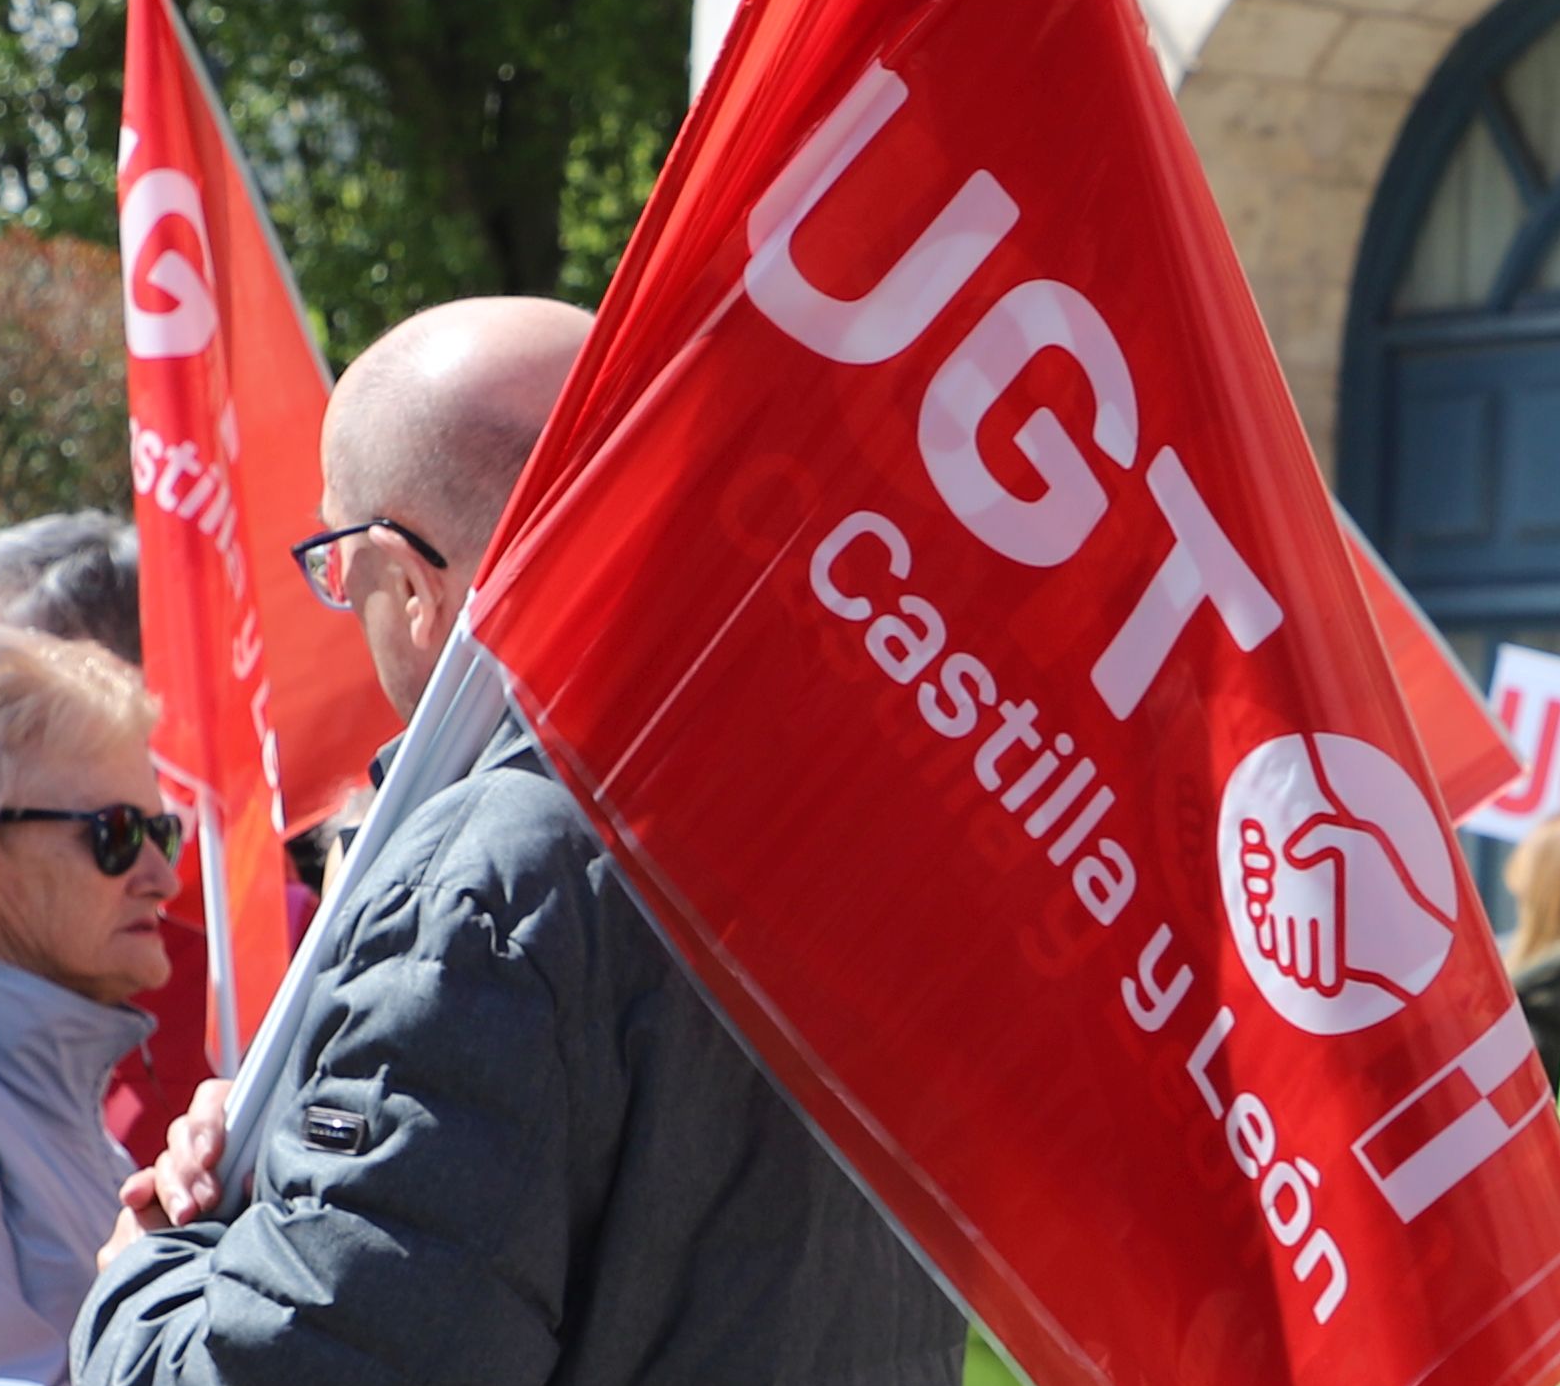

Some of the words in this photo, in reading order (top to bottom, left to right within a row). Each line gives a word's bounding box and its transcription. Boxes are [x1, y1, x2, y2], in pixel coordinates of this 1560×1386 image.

[743, 58, 1284, 721] UGT
[808, 510, 1138, 927] Castilla
[1120, 922, 1195, 1033] y
[1185, 1004, 1349, 1326] León
